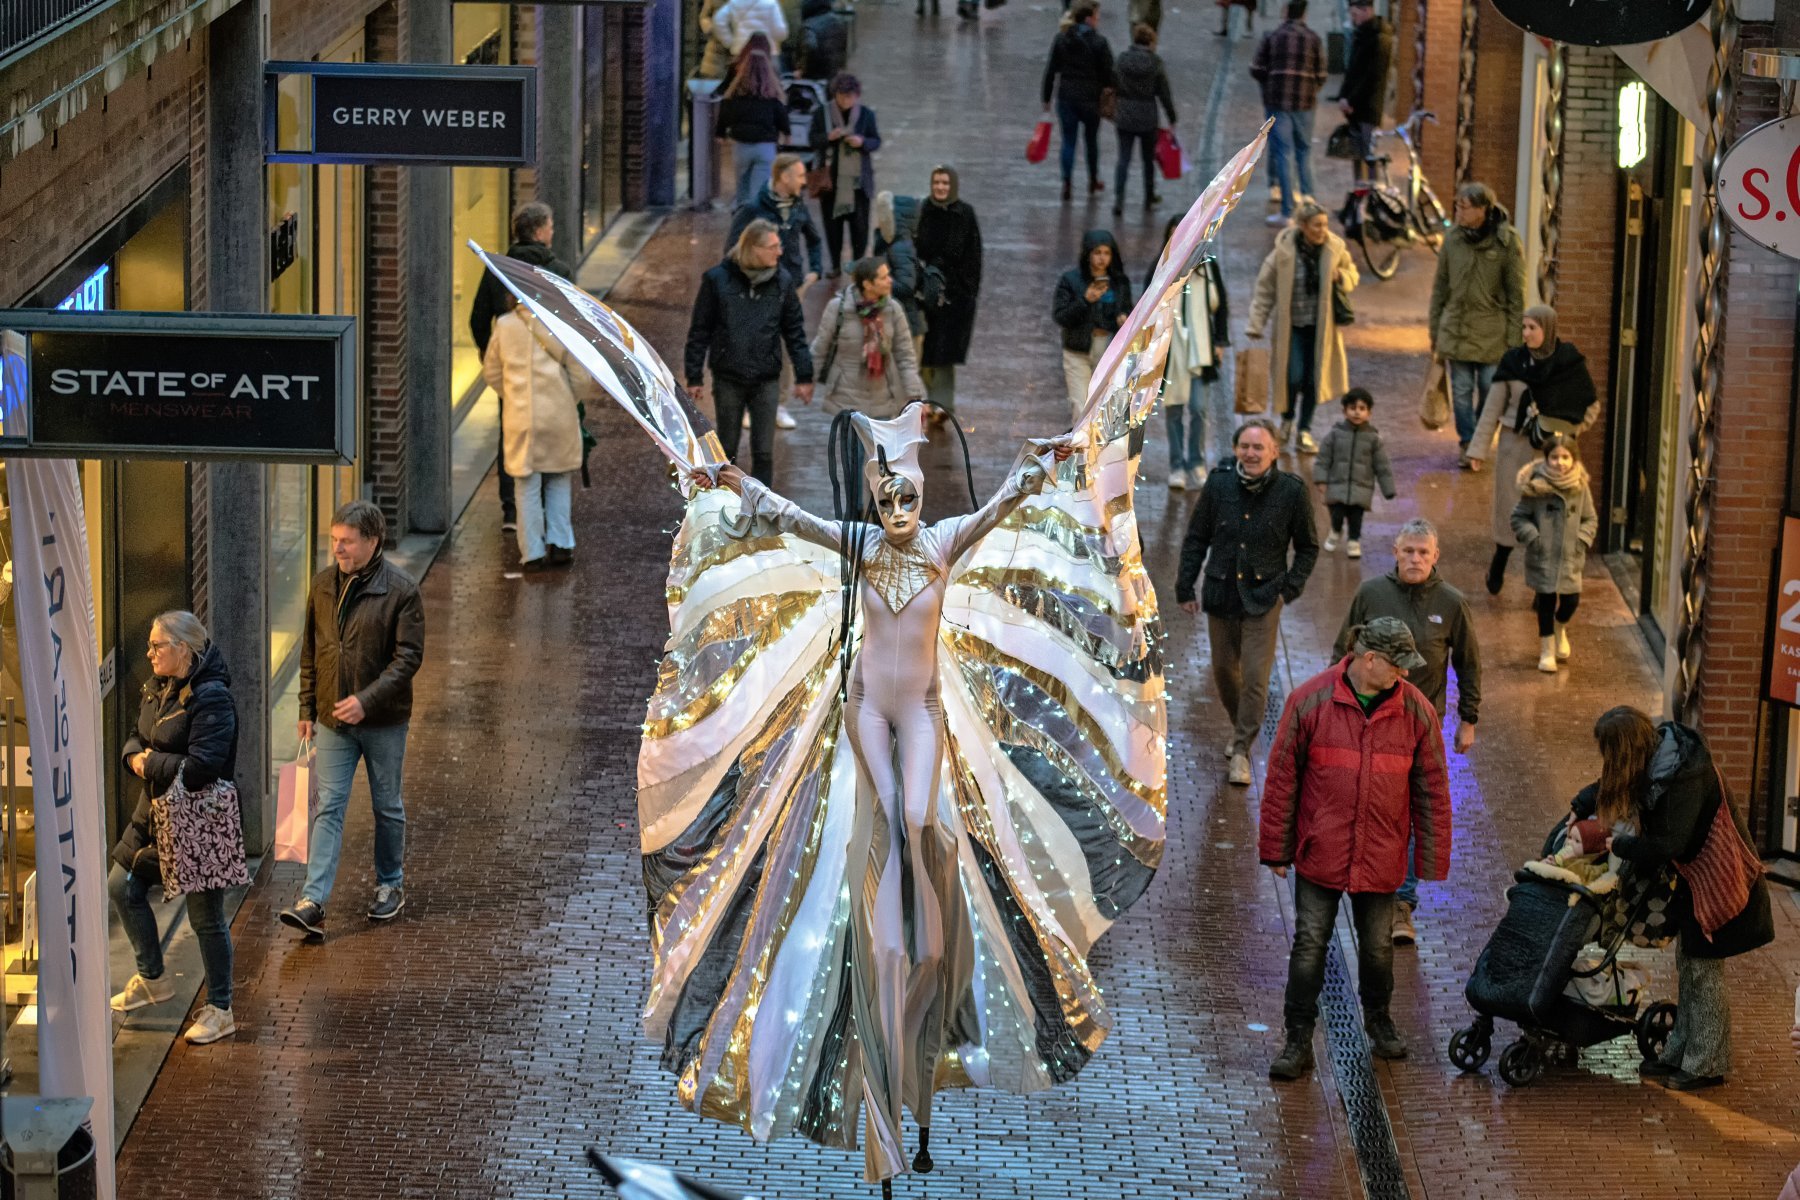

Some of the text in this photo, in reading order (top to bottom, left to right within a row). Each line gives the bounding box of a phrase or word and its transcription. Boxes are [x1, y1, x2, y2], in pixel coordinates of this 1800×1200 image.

[333, 107, 506, 129] GERRY WEBER
[50, 368, 320, 400] STATE OF ART
[109, 402, 252, 418] MENSWEAR
